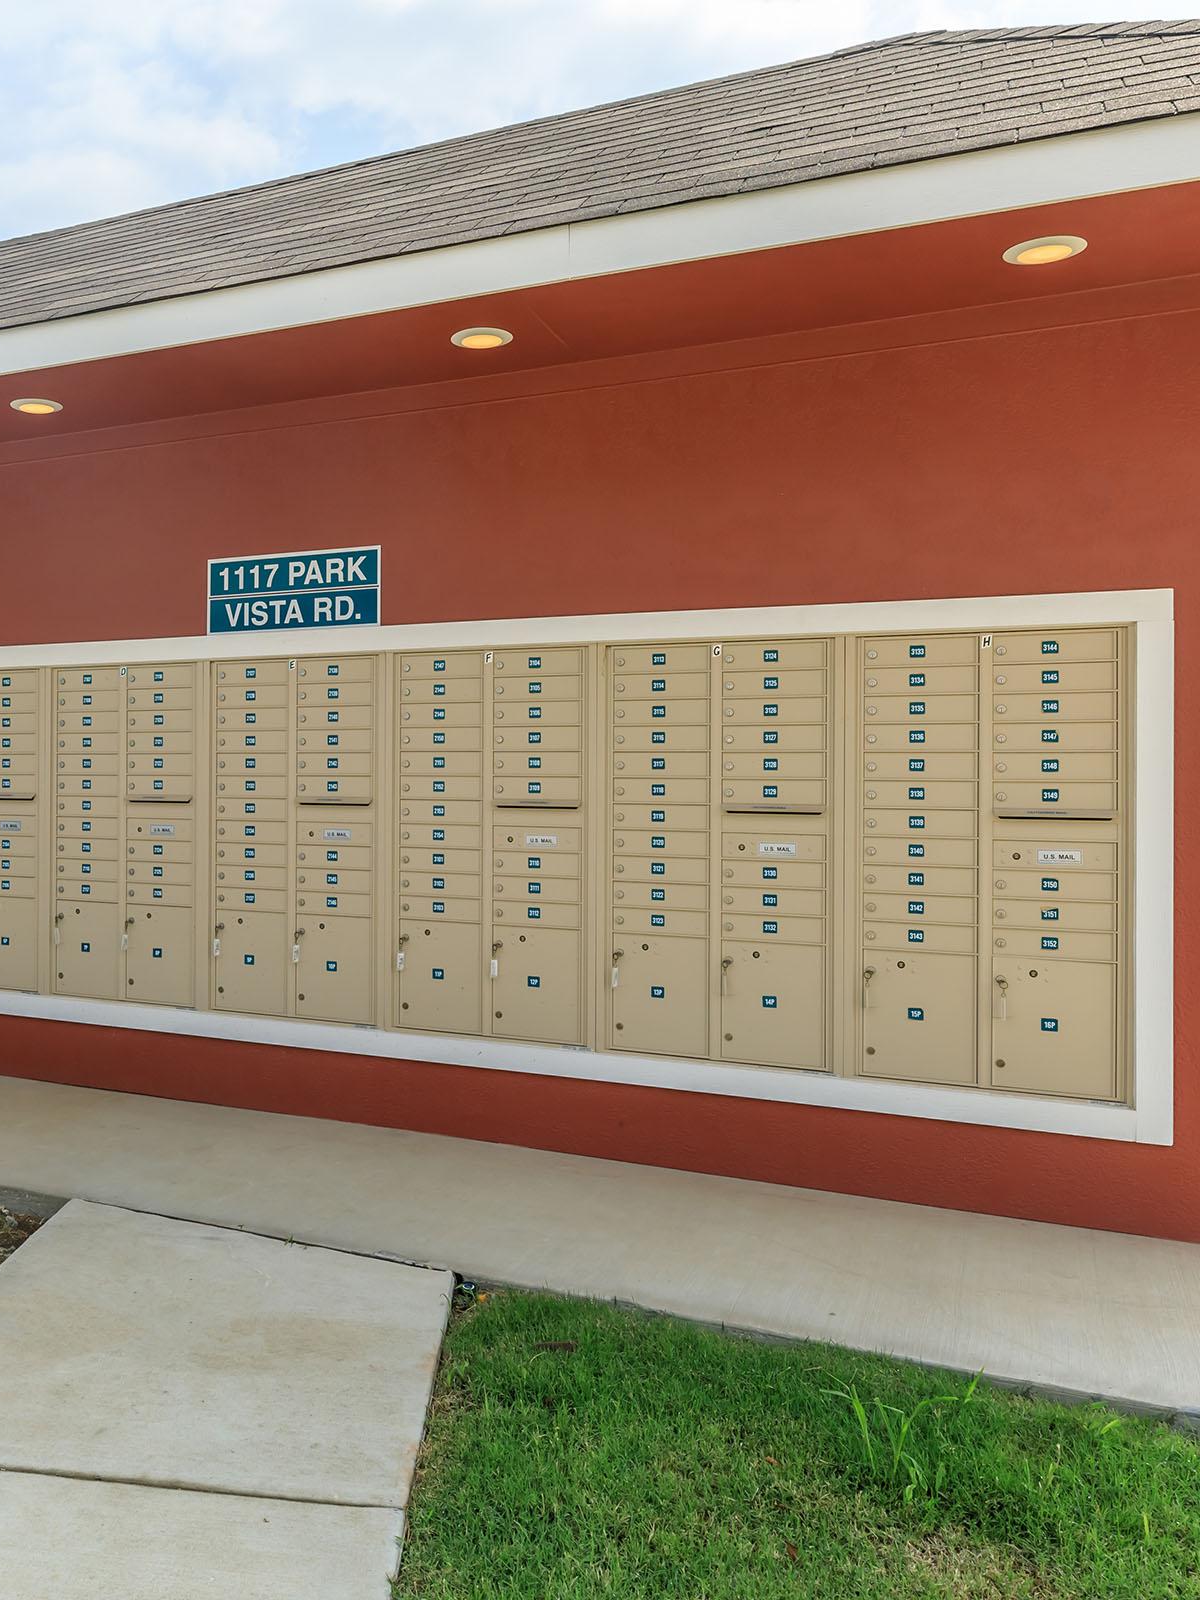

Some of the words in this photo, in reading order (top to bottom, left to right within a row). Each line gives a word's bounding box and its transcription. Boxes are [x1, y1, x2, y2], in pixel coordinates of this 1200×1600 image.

[219, 563, 280, 591] 1117
[288, 555, 368, 587] PARK
[225, 599, 304, 627] VISTA
[313, 595, 362, 623] RD.
[982, 636, 991, 647] H
[713, 646, 720, 656] G
[1042, 643, 1058, 652] 3144
[764, 652, 777, 660] 3124
[910, 648, 925, 656] 3133
[485, 652, 492, 663] F
[653, 655, 665, 663] 3113
[289, 660, 296, 669] E
[910, 676, 924, 684] 3134
[1043, 673, 1058, 681] 3145
[765, 679, 778, 687] 3125
[764, 706, 777, 714] 3126
[910, 704, 925, 712] 3135
[1042, 702, 1058, 711] 3146
[910, 733, 925, 741] 3136
[1042, 732, 1058, 740] 3147
[653, 760, 664, 768] 3117
[910, 761, 924, 769] 3137
[1042, 762, 1058, 770] 3148
[652, 786, 665, 794] 3118
[910, 790, 924, 798] 3138
[1043, 791, 1058, 800] 3149
[652, 812, 664, 820] 3119
[910, 818, 924, 826] 3139
[909, 847, 924, 855] 3140
[764, 869, 777, 877] 3130
[910, 875, 923, 883] 3141
[1042, 880, 1058, 889] 3150
[652, 891, 664, 899] 3122
[764, 896, 776, 904] 3131
[909, 904, 923, 912] 3142
[529, 909, 540, 917] 3112
[1042, 910, 1057, 918] 3151
[764, 923, 777, 931] 3132
[909, 932, 923, 940] 3143
[1042, 939, 1058, 948] 3152
[911, 1010, 922, 1018] 15P
[1044, 1021, 1056, 1029] 16P
